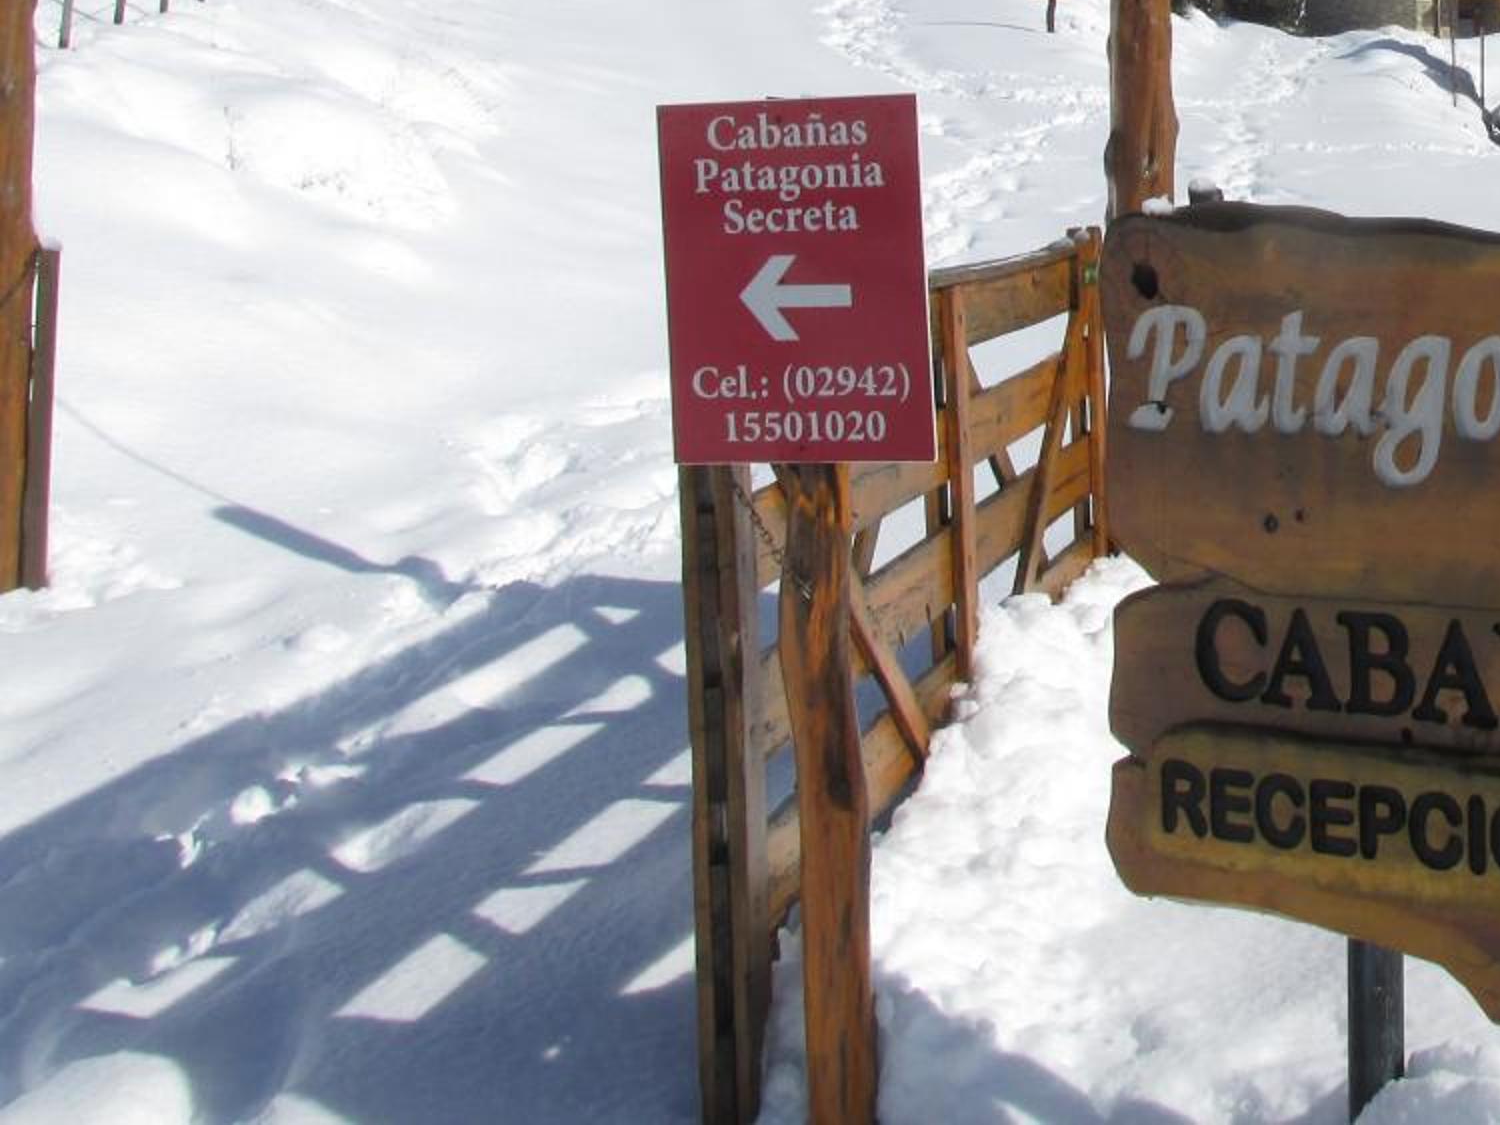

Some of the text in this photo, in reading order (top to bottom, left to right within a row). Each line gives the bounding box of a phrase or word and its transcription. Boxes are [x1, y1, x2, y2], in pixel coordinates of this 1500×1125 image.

[707, 114, 868, 150] Cabañas
[694, 153, 885, 202] Patagonia
[723, 199, 859, 234] Secreta
[692, 363, 911, 403] Cel.: (02942)
[725, 411, 887, 443] 15501020
